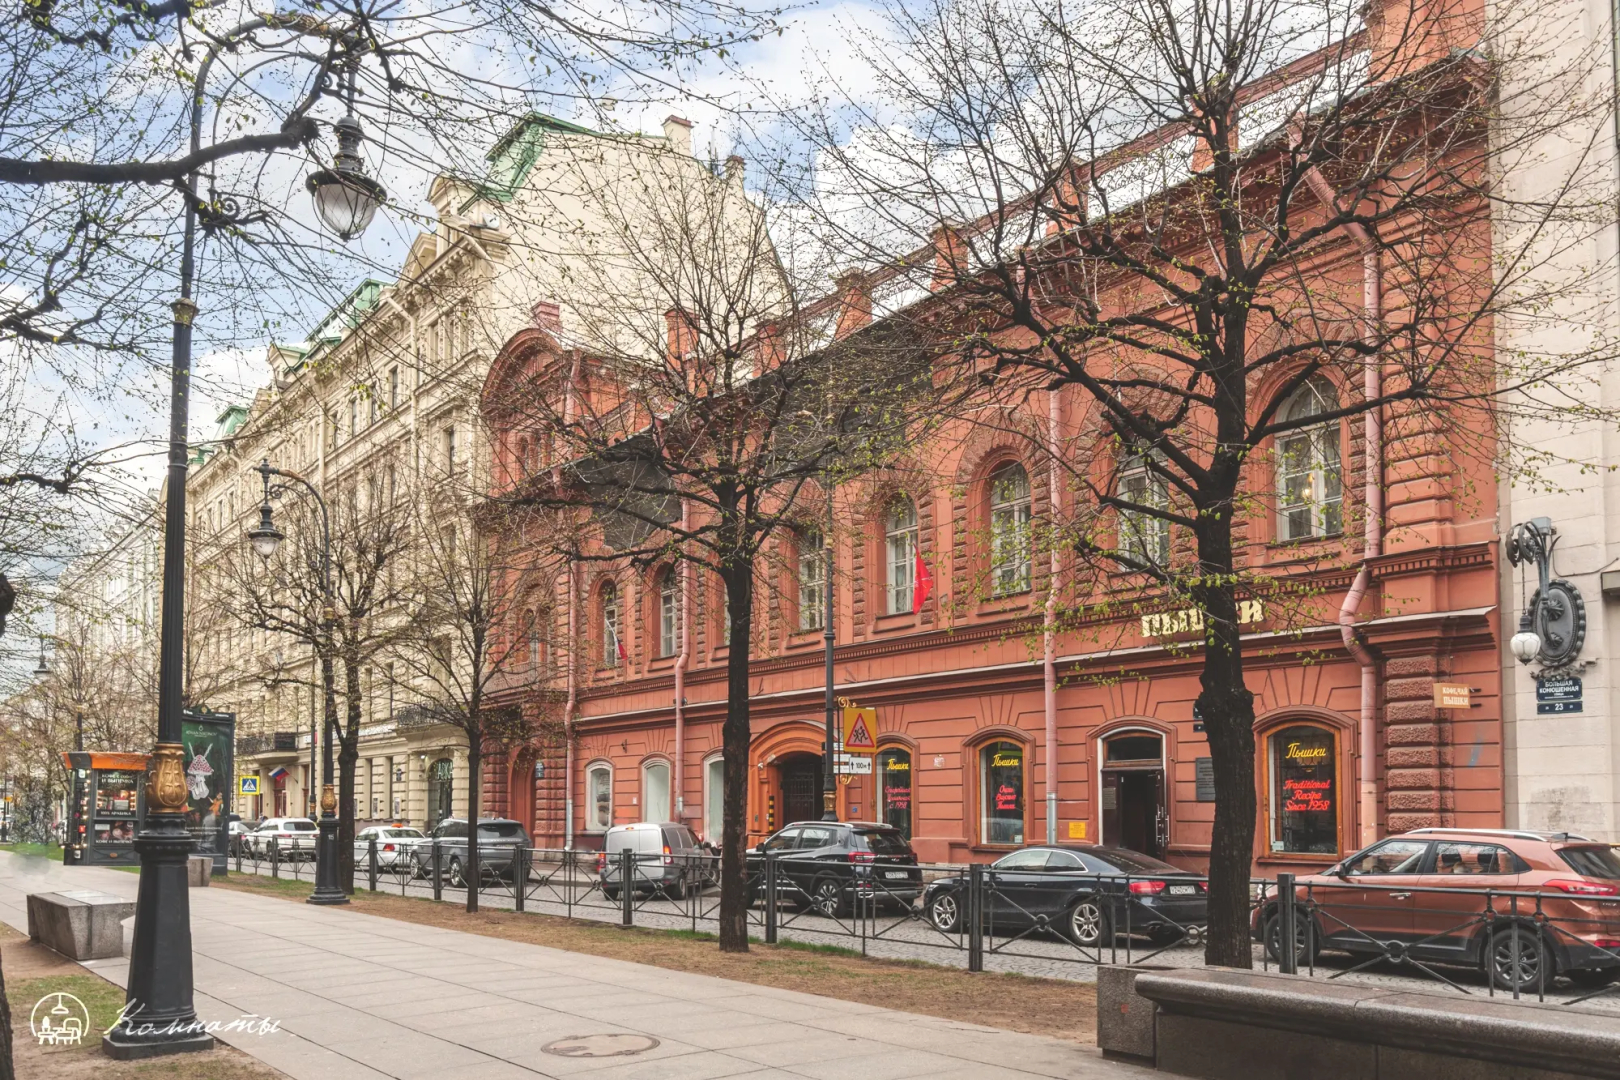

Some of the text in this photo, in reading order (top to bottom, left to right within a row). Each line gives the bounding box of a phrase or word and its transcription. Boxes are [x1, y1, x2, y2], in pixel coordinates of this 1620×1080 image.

[1545, 680, 1573, 688] БОЛЬШАЯ
[1539, 686, 1579, 694] КОНЮШЕННАЯ
[1444, 697, 1469, 705] ПЫШКИ
[1285, 742, 1327, 759] Пышки
[886, 758, 909, 770] Пышки
[991, 753, 1020, 767] Пышки
[1283, 779, 1331, 790] Traditional
[1292, 789, 1322, 801] Recipe
[894, 801, 908, 809] 1958
[1284, 799, 1330, 811] Since 1958
